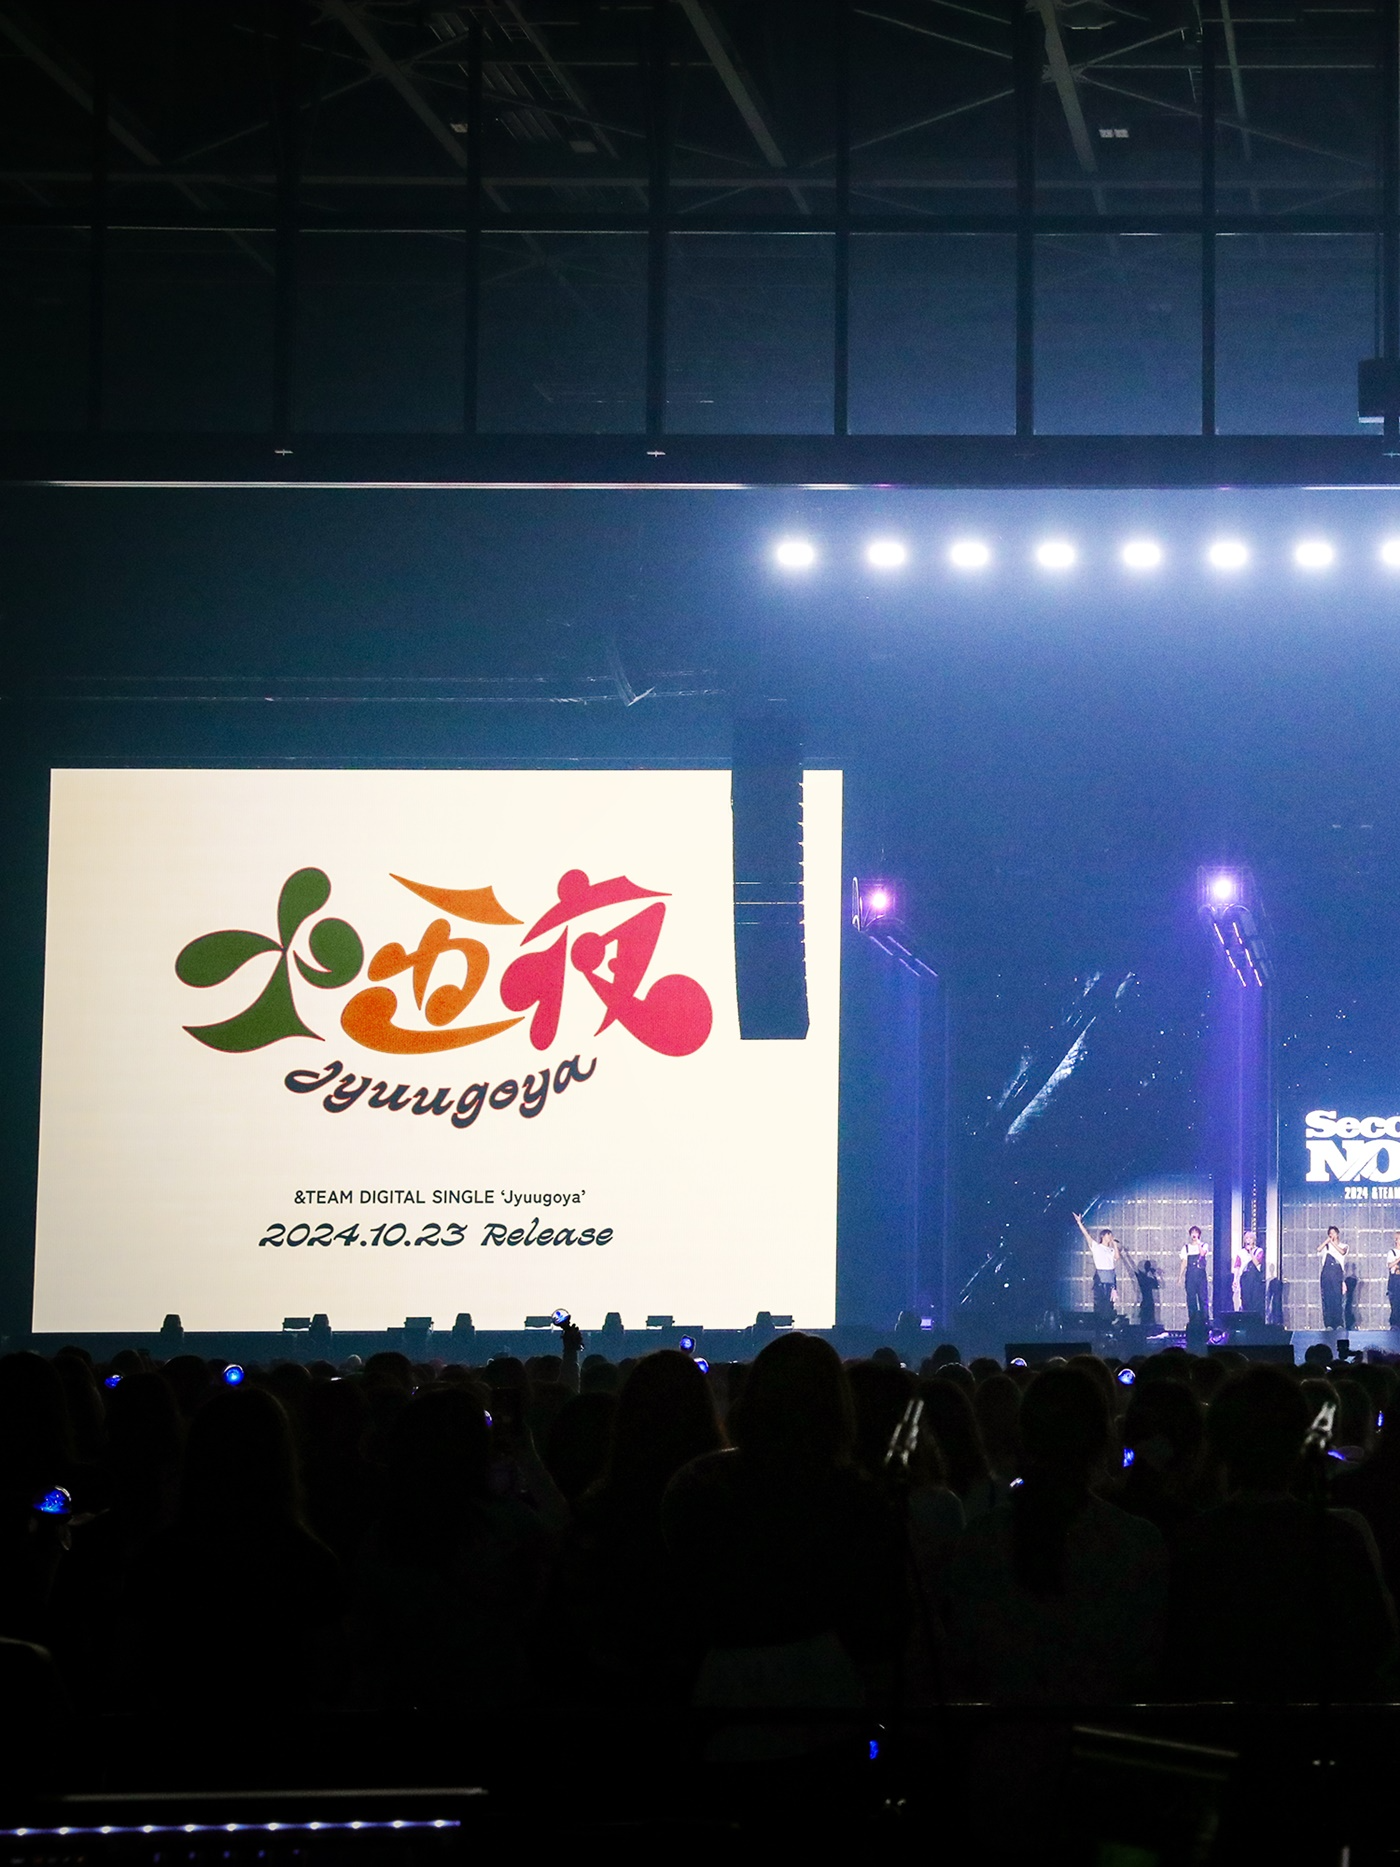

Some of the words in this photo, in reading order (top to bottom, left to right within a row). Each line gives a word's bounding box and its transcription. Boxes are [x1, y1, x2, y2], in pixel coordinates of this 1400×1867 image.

[284, 1054, 597, 1129] Jyuugoya
[294, 1189, 353, 1204] &TEAM
[359, 1189, 426, 1204] DIGITAL
[432, 1189, 495, 1204] SINGLE
[1344, 1186, 1369, 1200] 2024
[258, 1222, 468, 1248] 2024.10.23
[480, 1216, 614, 1247] Release
